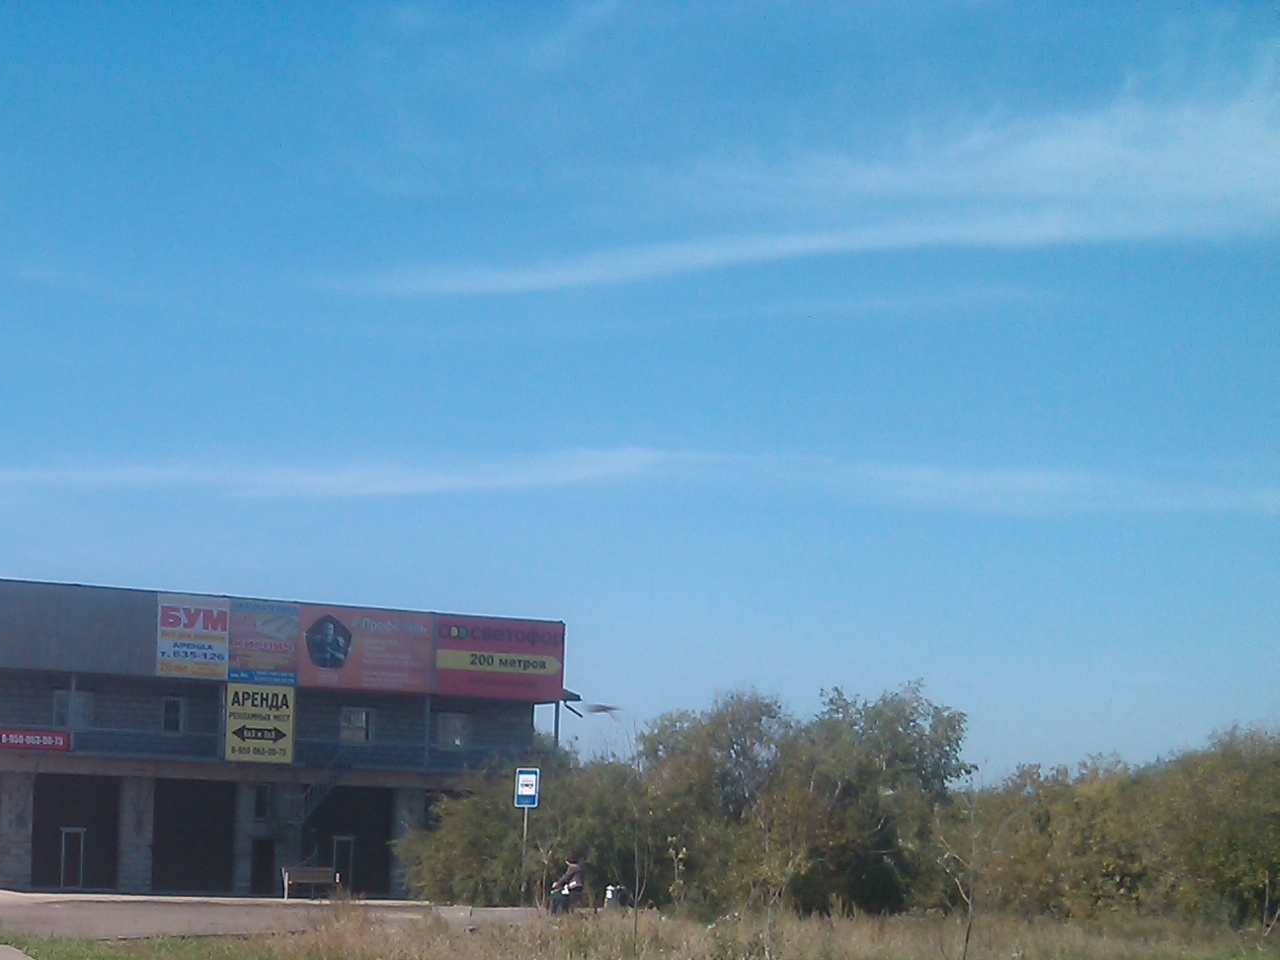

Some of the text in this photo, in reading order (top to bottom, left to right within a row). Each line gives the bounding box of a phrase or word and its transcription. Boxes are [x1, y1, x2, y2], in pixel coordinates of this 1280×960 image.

[161, 605, 228, 632] БУМ
[172, 642, 214, 651] АРЕНДА
[469, 653, 547, 671] 200 метров
[231, 690, 290, 711] АРЕНДА
